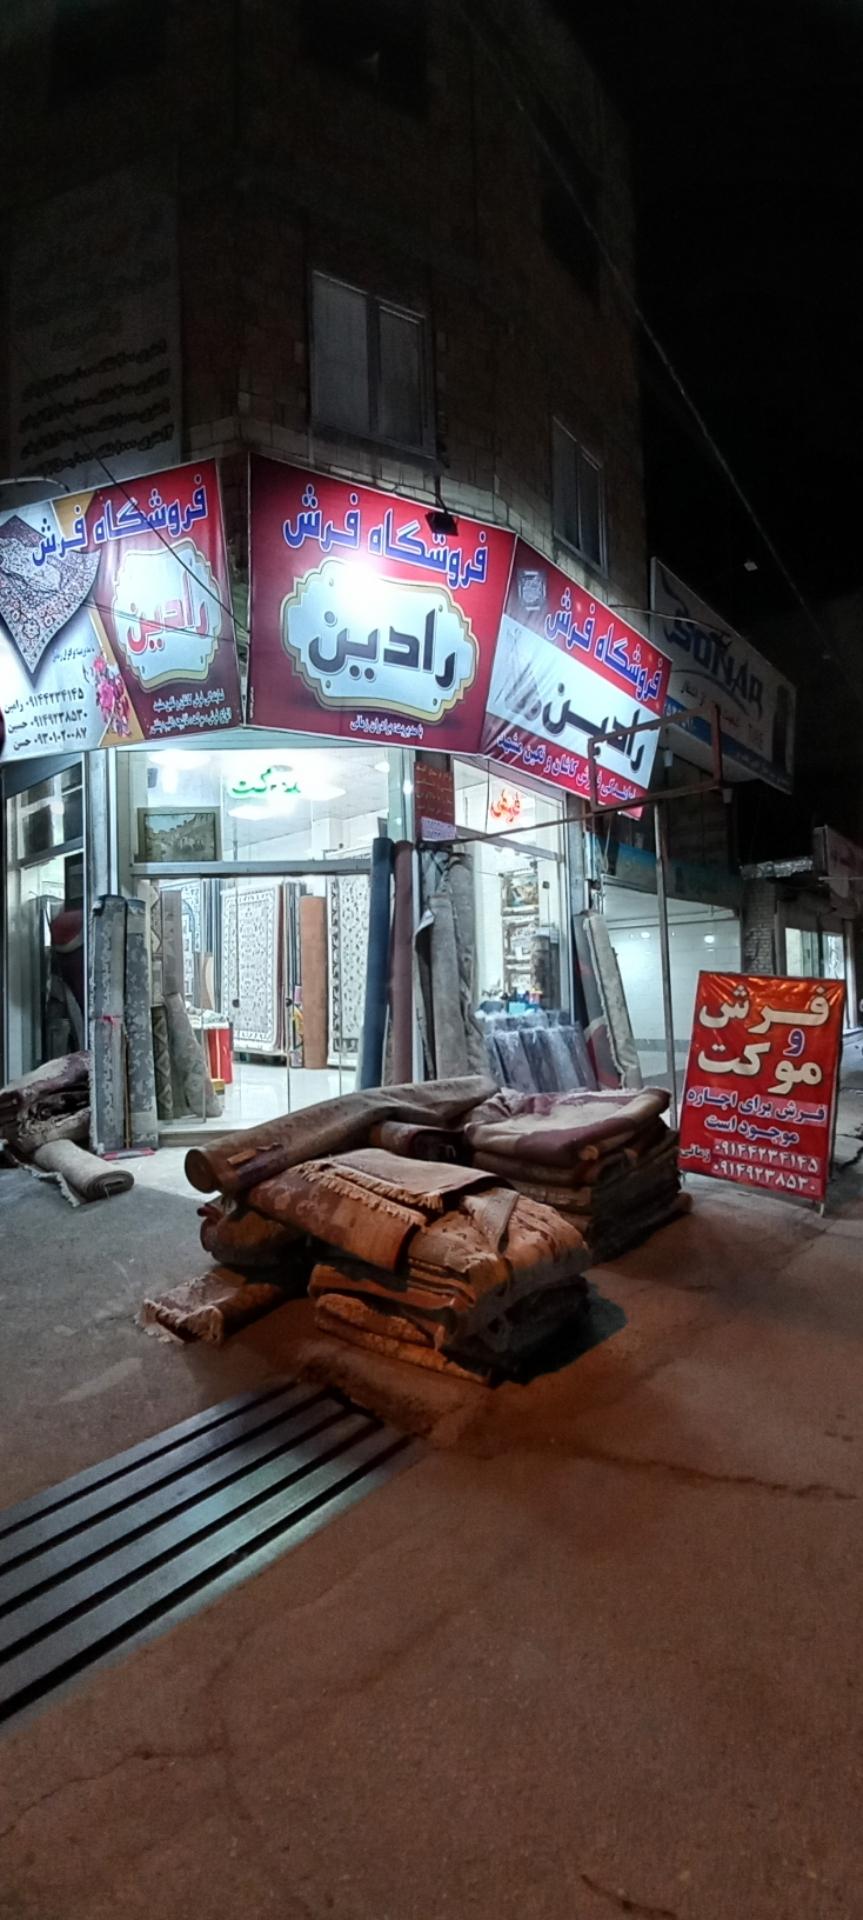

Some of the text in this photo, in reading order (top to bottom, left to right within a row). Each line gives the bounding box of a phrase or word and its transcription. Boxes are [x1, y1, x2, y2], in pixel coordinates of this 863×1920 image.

[32, 474, 208, 566] فروشگاه فرش
[283, 484, 489, 589] فروشگاه فرش
[126, 569, 208, 654] رادین
[544, 586, 595, 652] فرش
[308, 608, 456, 689] رادین
[595, 623, 663, 701] فروشگاه
[664, 607, 764, 721] SONAR
[25, 687, 84, 708] ۰۹۱۴۴۲۳۴۱۴۵
[30, 709, 88, 727] ۰۹۱۴۹۲۳۸۵۳۰
[496, 732, 523, 754] مشهد
[541, 682, 646, 772] رادین
[549, 753, 579, 777] کاشان
[699, 984, 830, 1034] فرش
[783, 1027, 805, 1057] و
[697, 1042, 822, 1095] موکت
[686, 1087, 826, 1123] فرش برای اجاره
[704, 1115, 800, 1146] موجود است
[680, 1140, 819, 1173] ۰۹۱۴۴۲۳۴۱۴۵ زمانی
[713, 1160, 817, 1192] ۰۹۱۴۹۲۳۸۵۳۰
